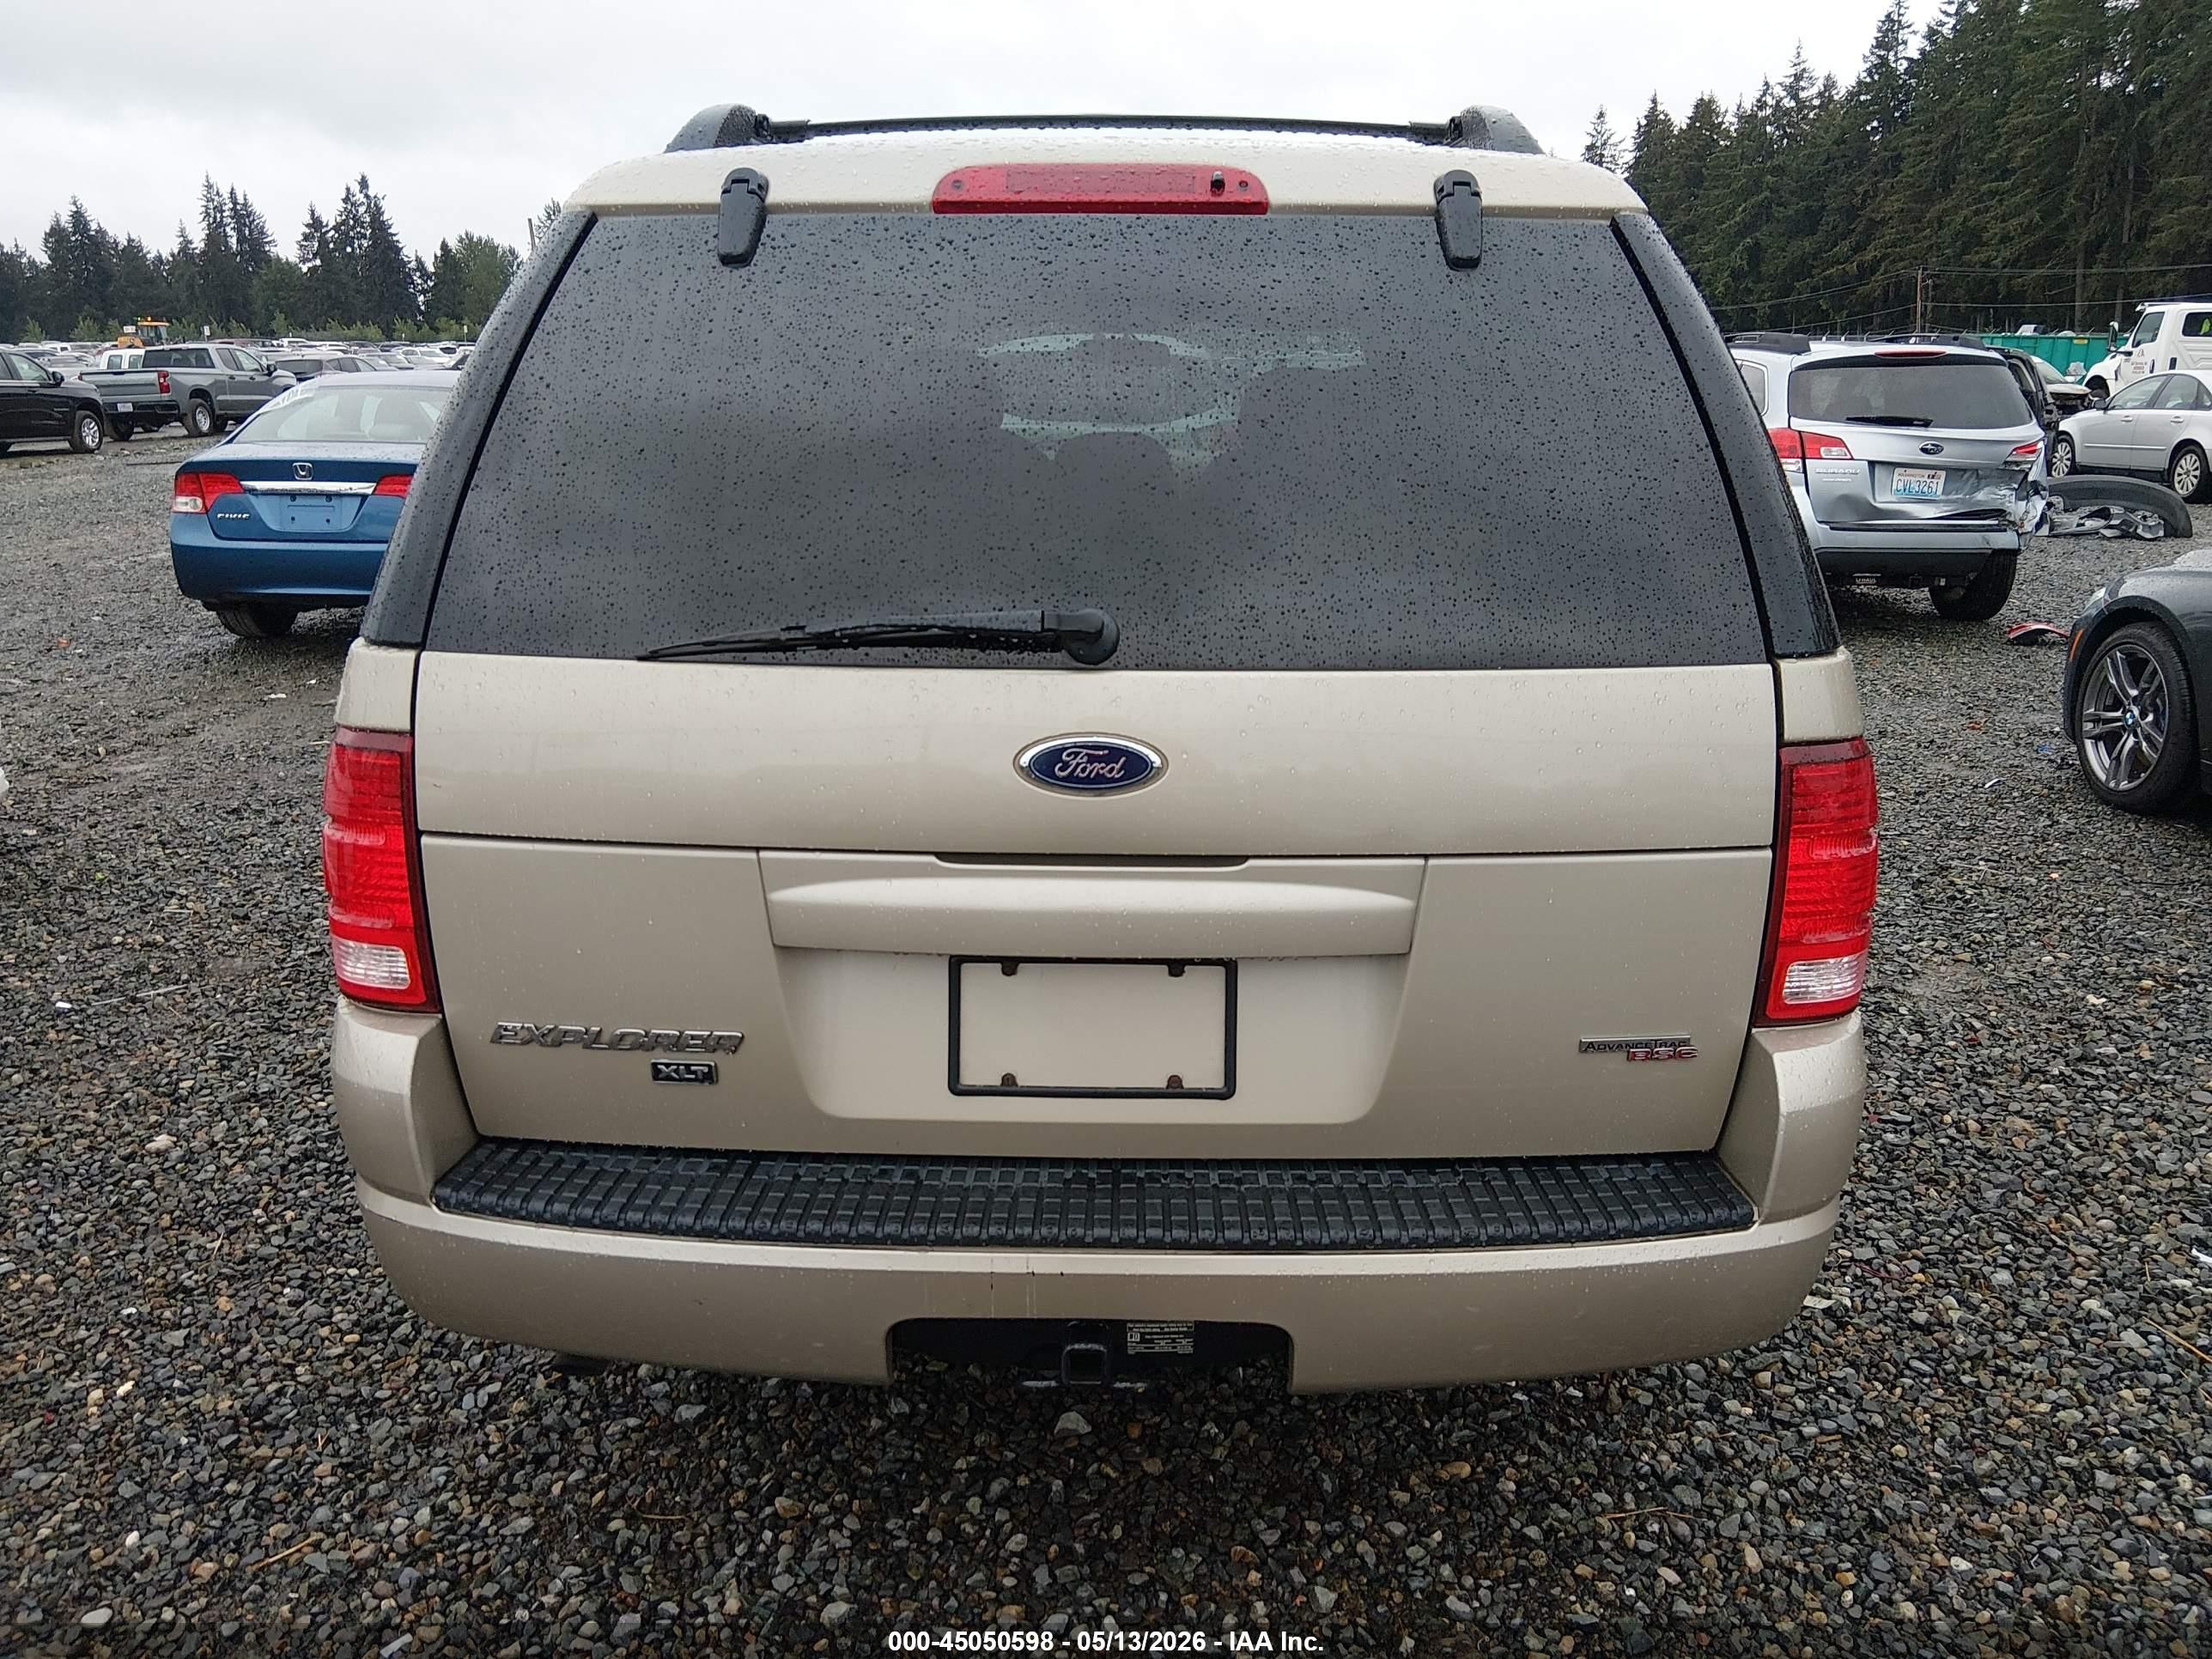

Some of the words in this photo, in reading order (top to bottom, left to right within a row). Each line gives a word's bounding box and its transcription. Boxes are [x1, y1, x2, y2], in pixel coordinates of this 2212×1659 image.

[1895, 478, 1940, 495] CVL3261
[1054, 747, 1127, 779] Ford
[491, 1021, 744, 1054] EXPLORER
[655, 1062, 711, 1080] XLT
